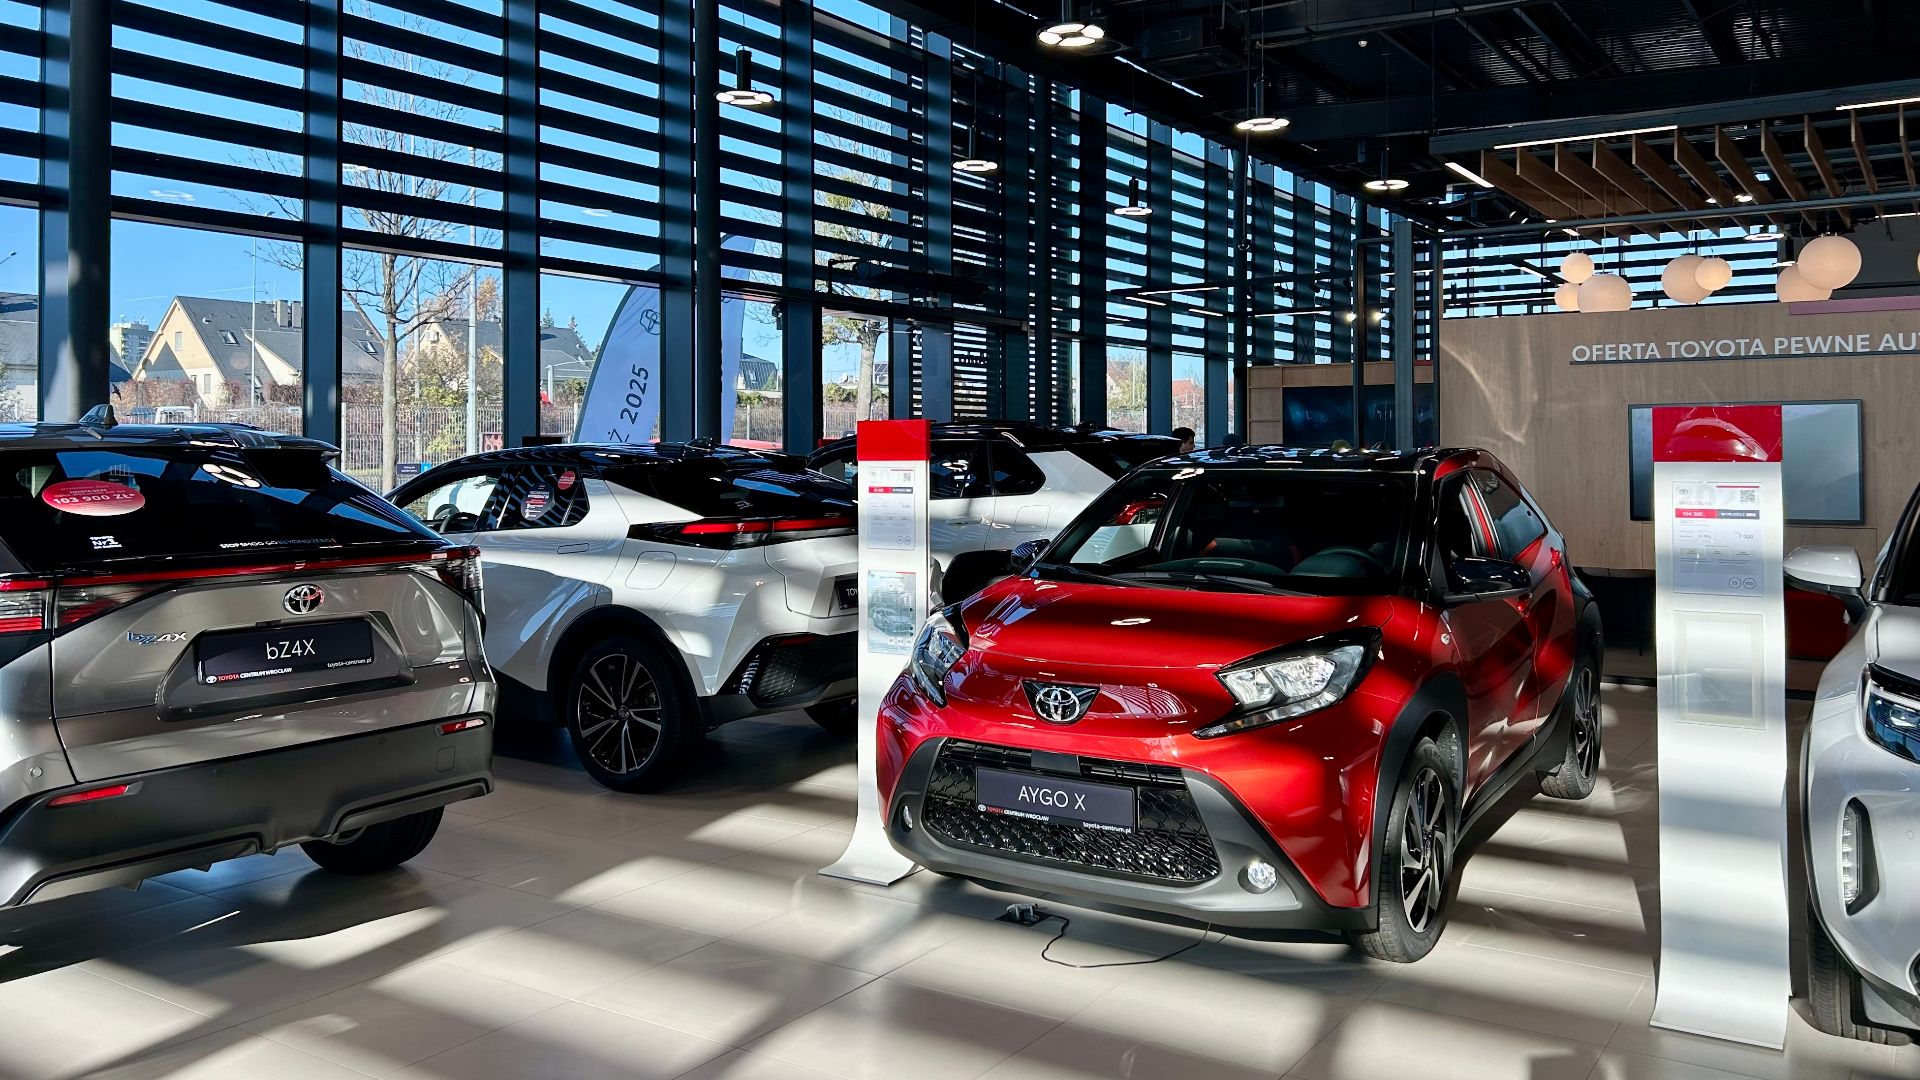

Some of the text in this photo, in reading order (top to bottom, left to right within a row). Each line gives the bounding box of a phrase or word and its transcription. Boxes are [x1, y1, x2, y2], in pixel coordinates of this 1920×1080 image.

[1571, 332, 1920, 362] OFERTA TOYOTA PEWNE AU
[619, 364, 649, 425] 2025
[53, 496, 79, 504] 103
[82, 494, 110, 502] 900
[266, 638, 316, 660] bZ4X
[327, 656, 373, 669] toyota-centrum.pl
[217, 673, 240, 682] TOYOTA
[240, 670, 265, 679] CENTRUM
[1018, 785, 1086, 811] AYGO X
[987, 806, 1004, 815] TOYOTA
[1003, 809, 1025, 818] CENTRUM
[1082, 821, 1132, 835] toyota-centrum.pl
